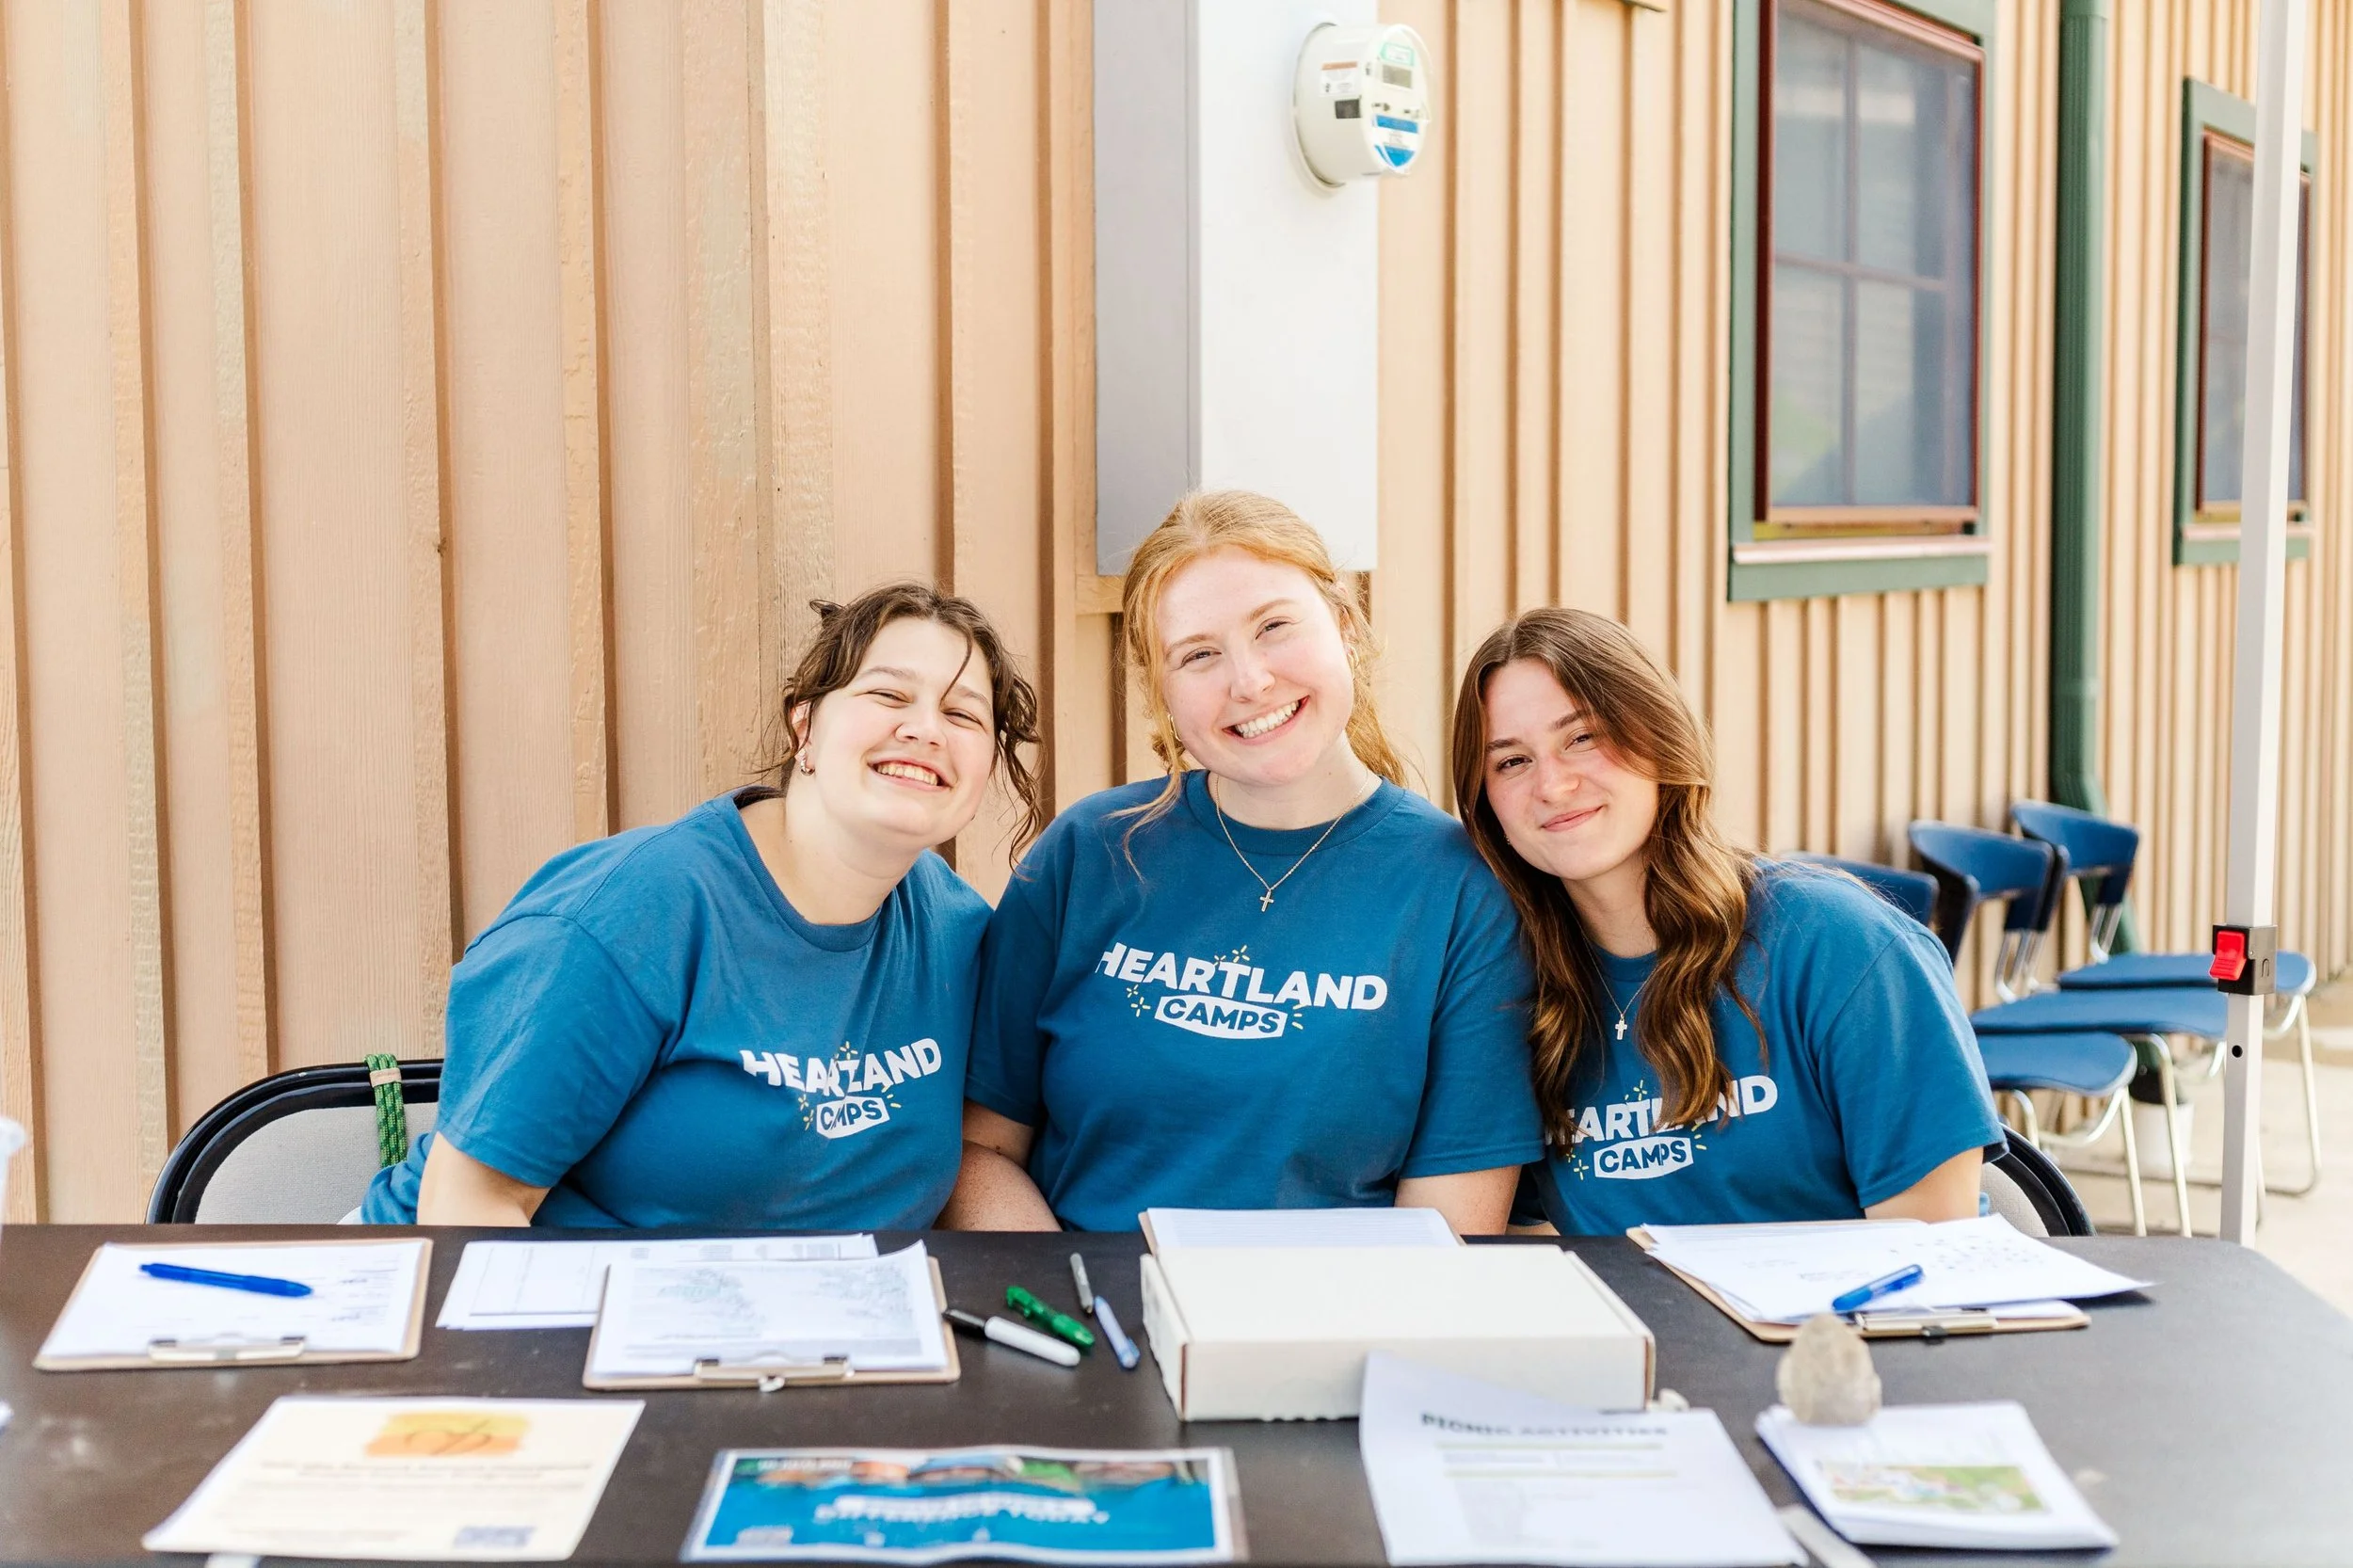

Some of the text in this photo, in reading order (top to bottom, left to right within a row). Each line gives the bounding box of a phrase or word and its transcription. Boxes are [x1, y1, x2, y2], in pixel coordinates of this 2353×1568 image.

[1095, 942, 1388, 1010] HEARTLAND
[1162, 998, 1280, 1033] CAMPS
[820, 1099, 883, 1130] CMPS
[1598, 1140, 1688, 1174] CAMPS
